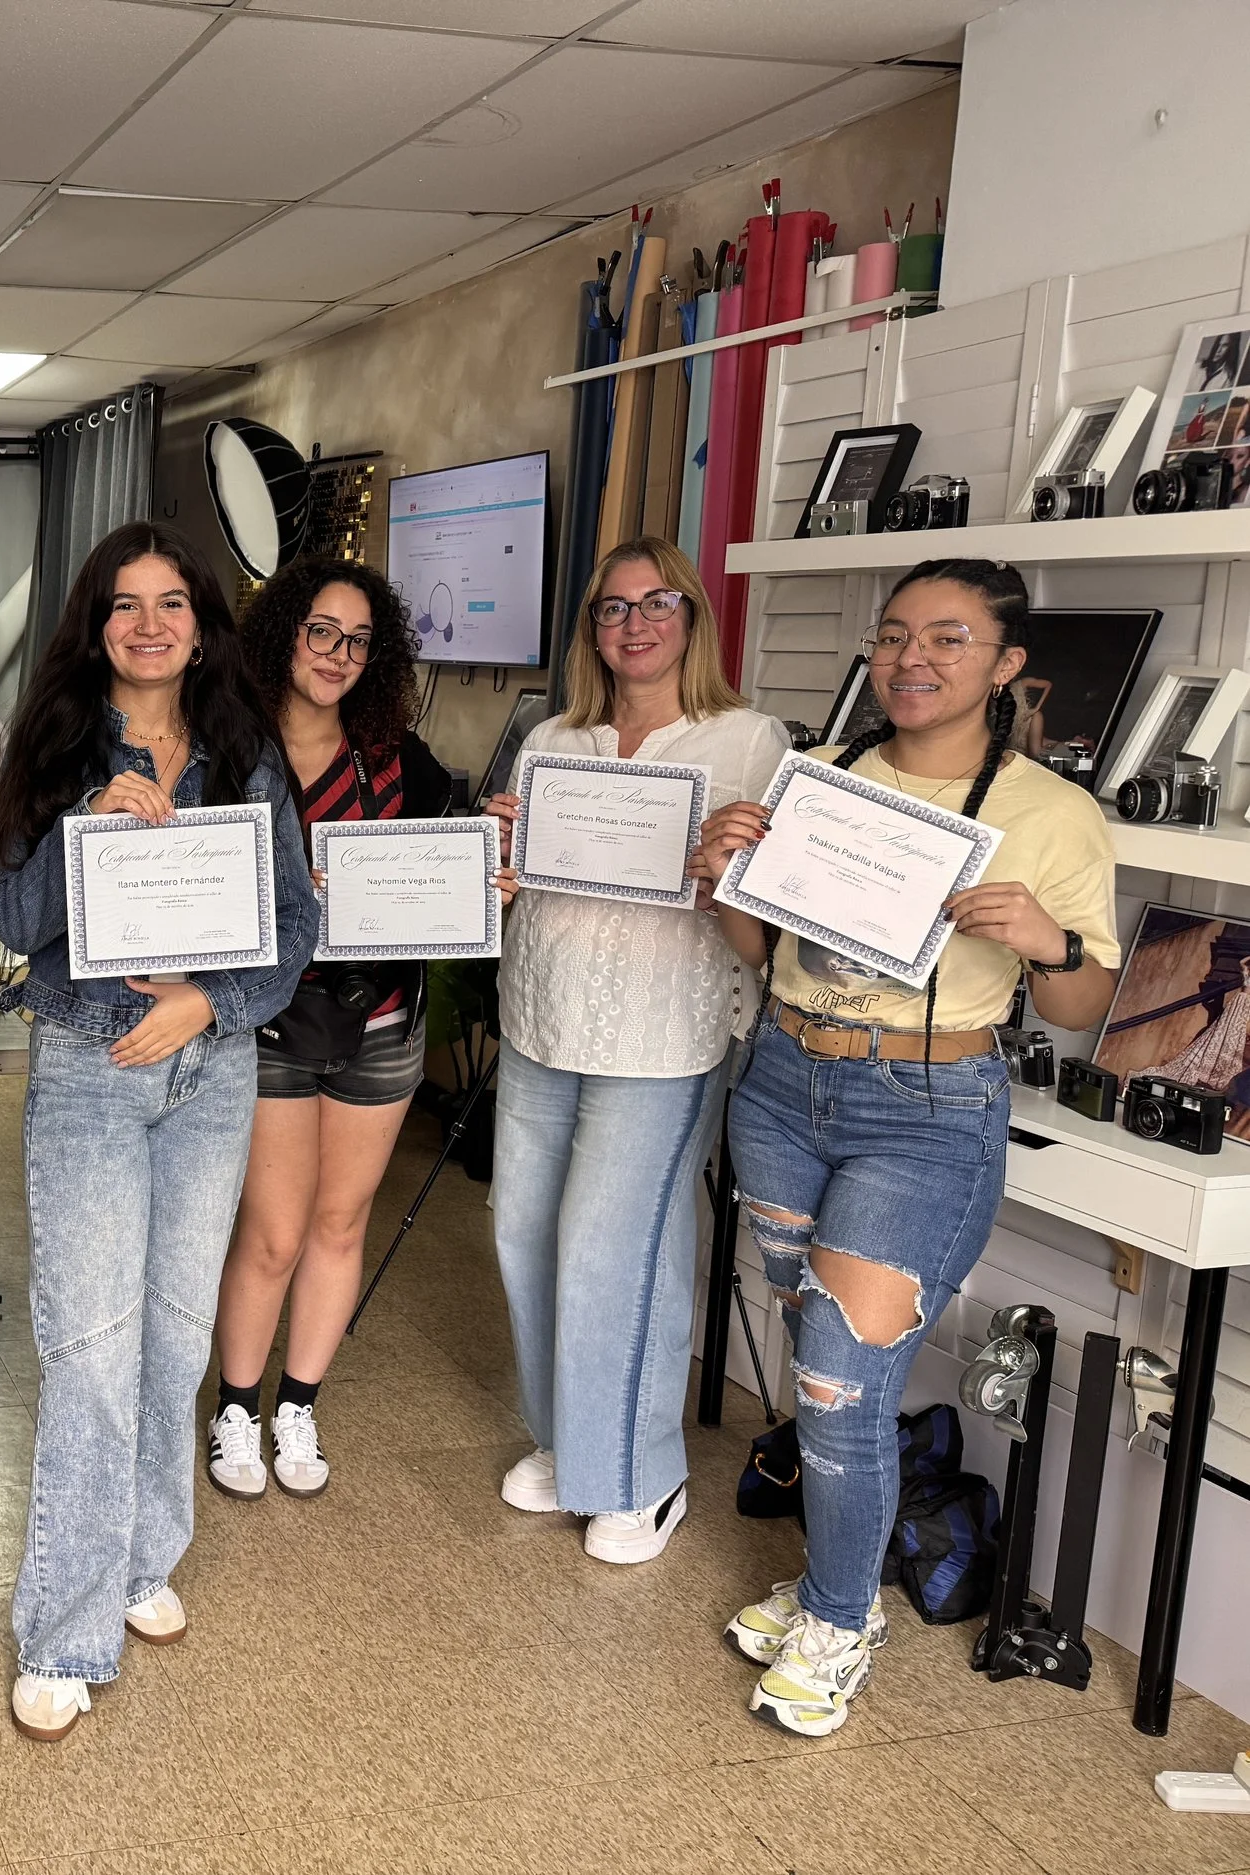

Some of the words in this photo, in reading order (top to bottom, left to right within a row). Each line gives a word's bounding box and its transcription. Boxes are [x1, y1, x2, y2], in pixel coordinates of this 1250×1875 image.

[353, 750, 367, 783] Canon
[557, 812, 594, 823] Gretchen
[595, 816, 619, 825] Rosas
[807, 833, 840, 853] Shakira
[841, 848, 872, 867] Padilla
[874, 862, 907, 882] Valpais
[118, 880, 139, 888] Ilana
[141, 879, 178, 888] Montero
[180, 876, 225, 886] Fernández
[367, 878, 406, 887] Nayhomie
[408, 878, 427, 887] Vega
